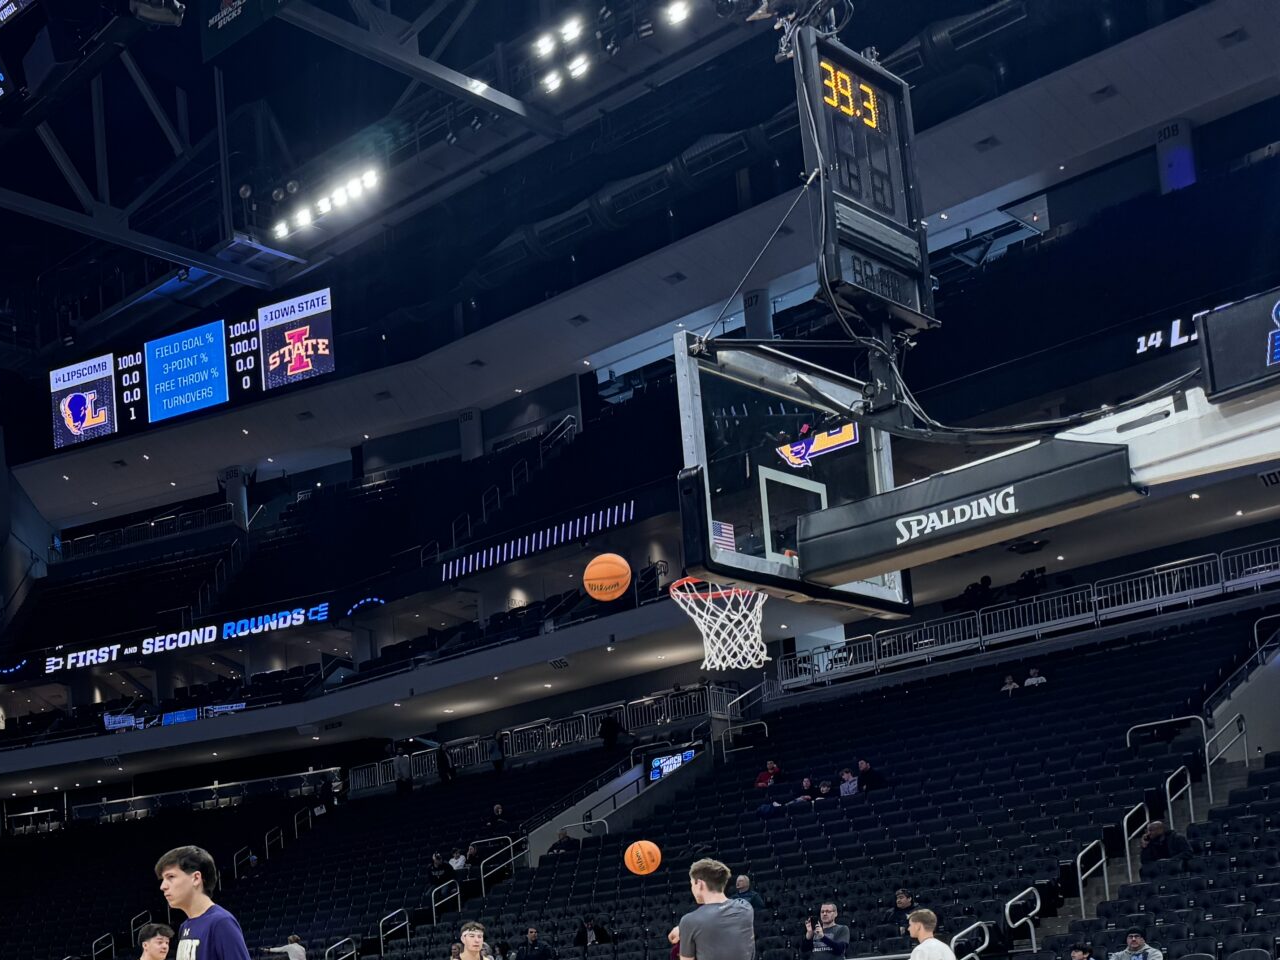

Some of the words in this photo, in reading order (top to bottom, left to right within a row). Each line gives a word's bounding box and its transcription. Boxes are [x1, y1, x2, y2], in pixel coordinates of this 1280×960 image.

[820, 61, 876, 129] 39.3
[269, 304, 296, 322] IOWA
[297, 295, 327, 313] STATE
[229, 318, 257, 339] 100.0
[155, 341, 180, 359] FIELD
[182, 335, 205, 351] GOAL
[205, 332, 214, 344] %
[230, 337, 258, 357] 100.0
[1136, 330, 1163, 354] 14
[117, 351, 142, 371] 100.0
[162, 354, 198, 375] 3-POINT
[200, 352, 209, 364] %
[235, 355, 255, 373] 0.0
[269, 338, 329, 371] STATE
[62, 361, 107, 383] LIPSCOMB
[122, 370, 140, 387] 0.0
[154, 378, 176, 396] FREE
[177, 369, 209, 388] THROW
[210, 367, 219, 379] %
[242, 375, 251, 390] 0
[123, 387, 141, 404] 0.0
[162, 386, 213, 411] TURNOVERS
[129, 407, 136, 421] 1
[1261, 470, 1280, 488] 10
[896, 486, 1017, 546] SPALDING
[66, 645, 121, 670] FIRST
[123, 645, 138, 656] AND
[141, 625, 217, 655] SECOND
[222, 607, 305, 640] ROUNDS
